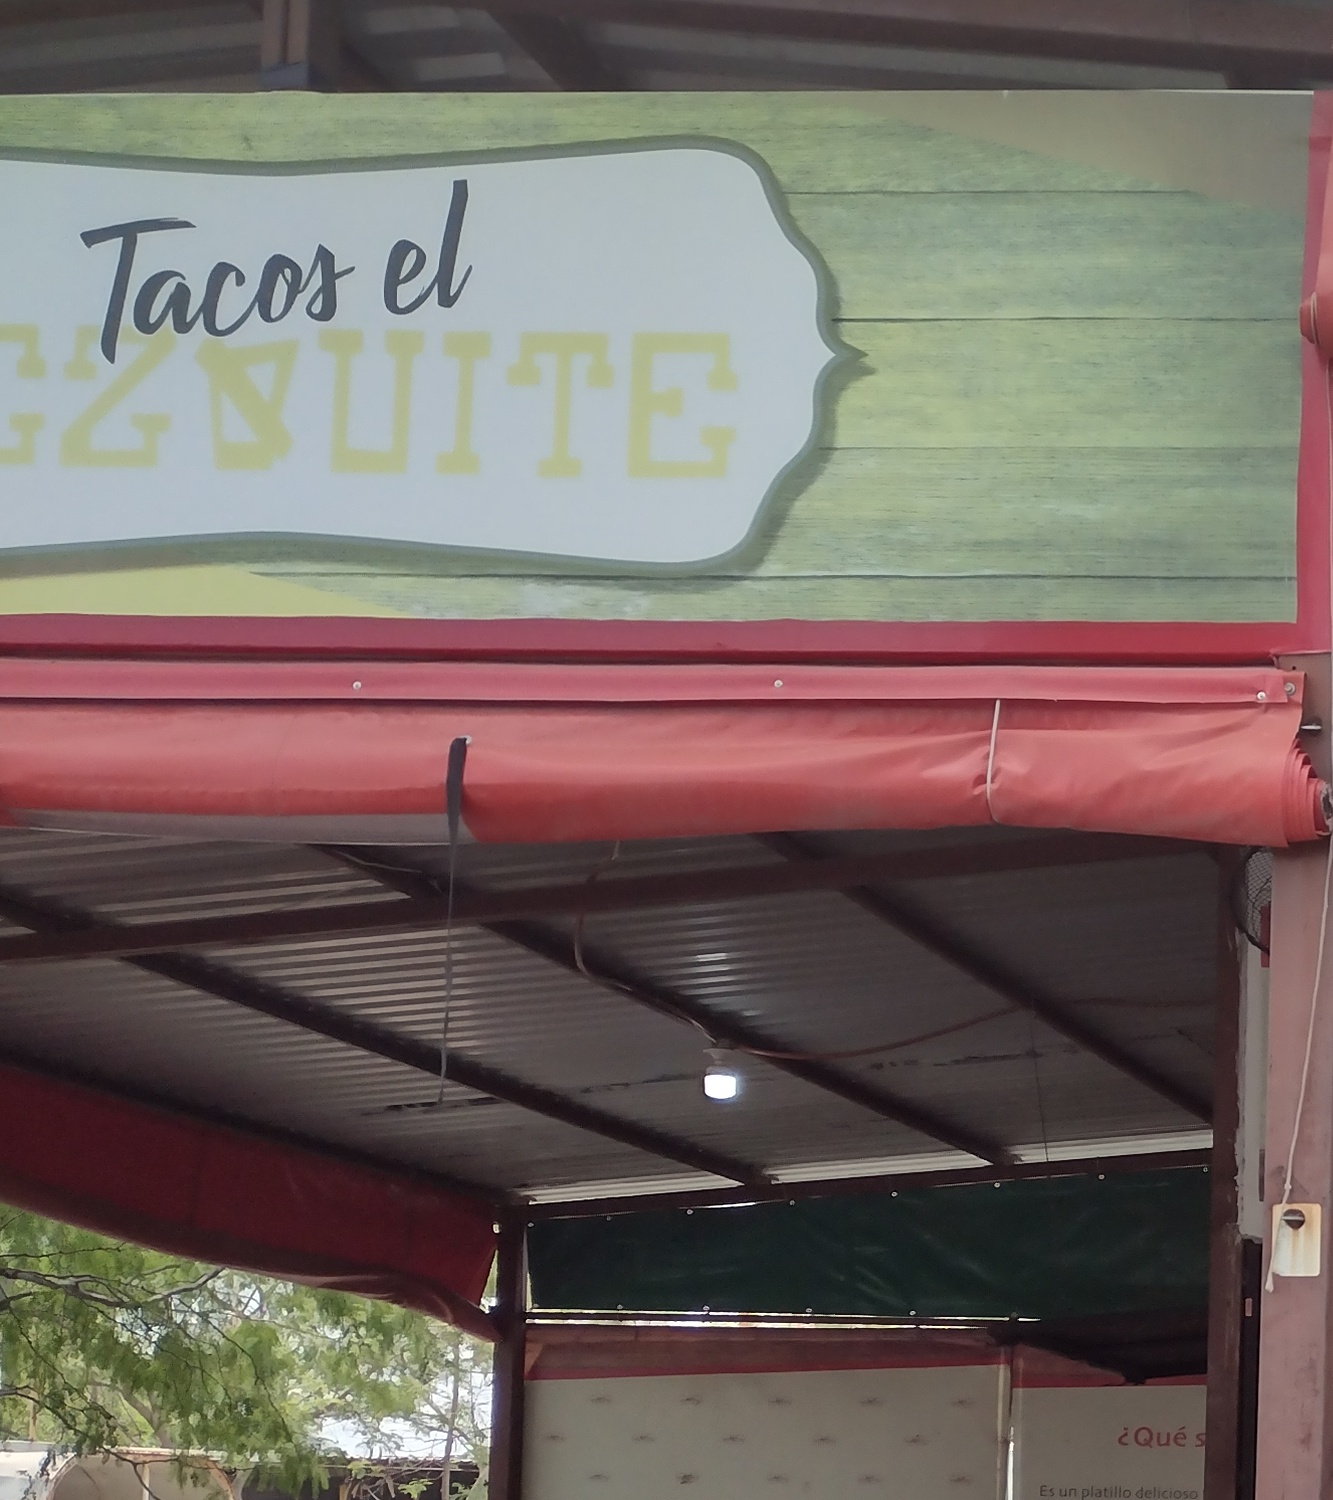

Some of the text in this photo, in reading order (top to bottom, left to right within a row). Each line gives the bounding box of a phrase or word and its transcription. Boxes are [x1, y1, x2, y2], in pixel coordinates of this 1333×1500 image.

[79, 179, 472, 364] Tacos el
[1117, 1426, 1187, 1448] ¿Qué
[1039, 1485, 1055, 1498] Es
[1059, 1487, 1077, 1498] un
[1135, 1486, 1198, 1500] delicioso
